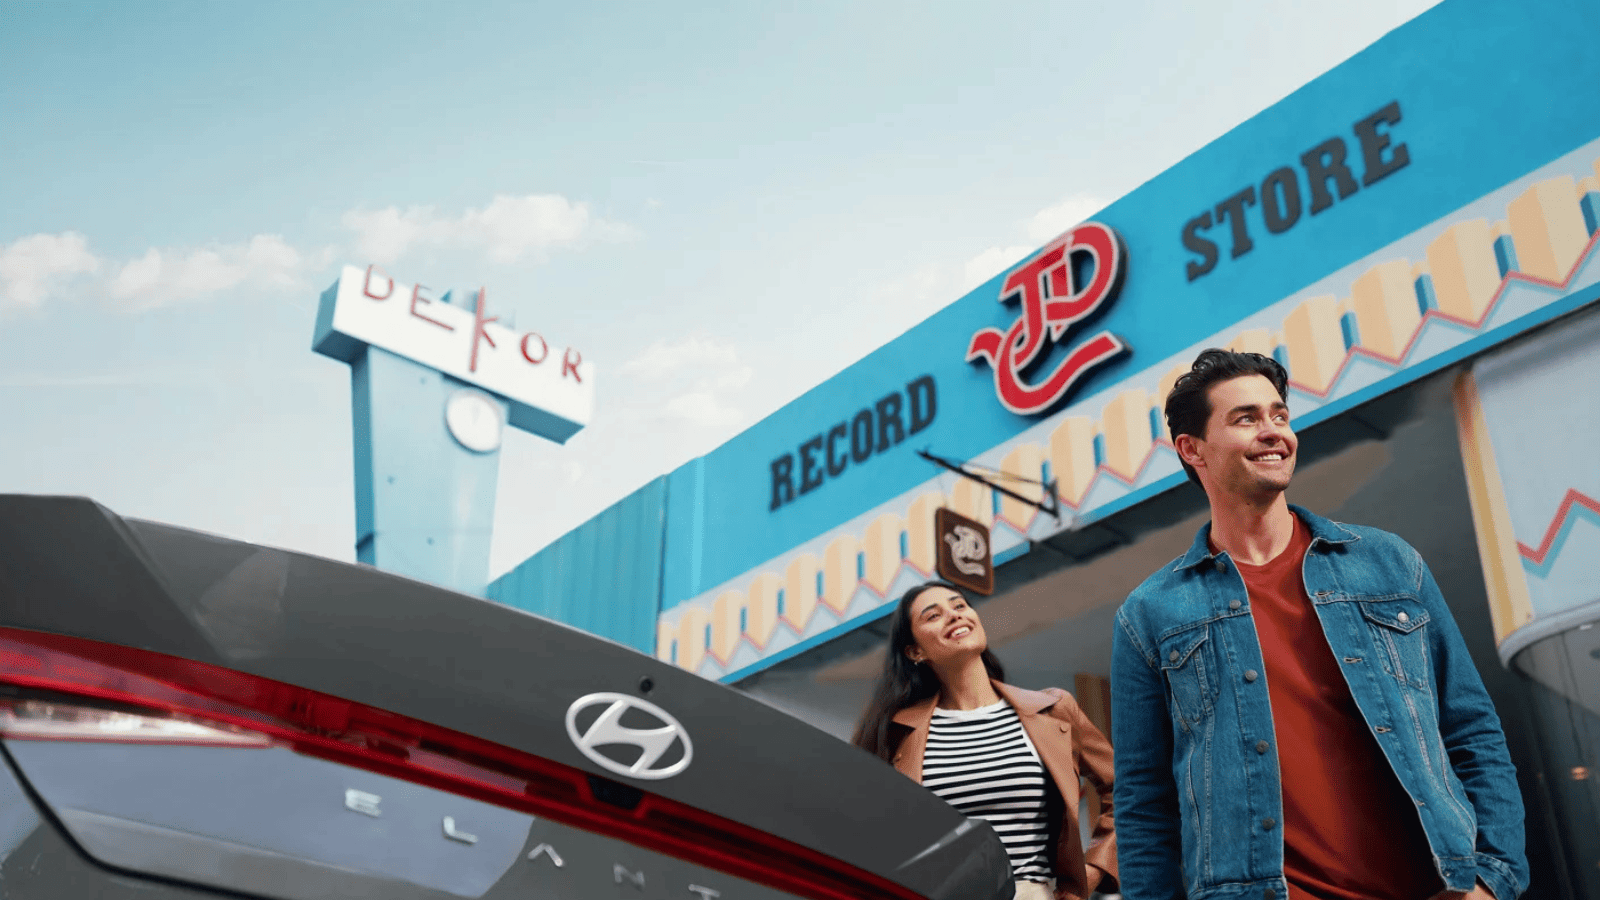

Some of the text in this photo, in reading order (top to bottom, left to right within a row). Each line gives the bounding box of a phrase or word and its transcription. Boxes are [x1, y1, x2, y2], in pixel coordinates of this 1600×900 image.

[363, 264, 582, 383] DEKOR
[769, 100, 1410, 512] RECORD STORE
